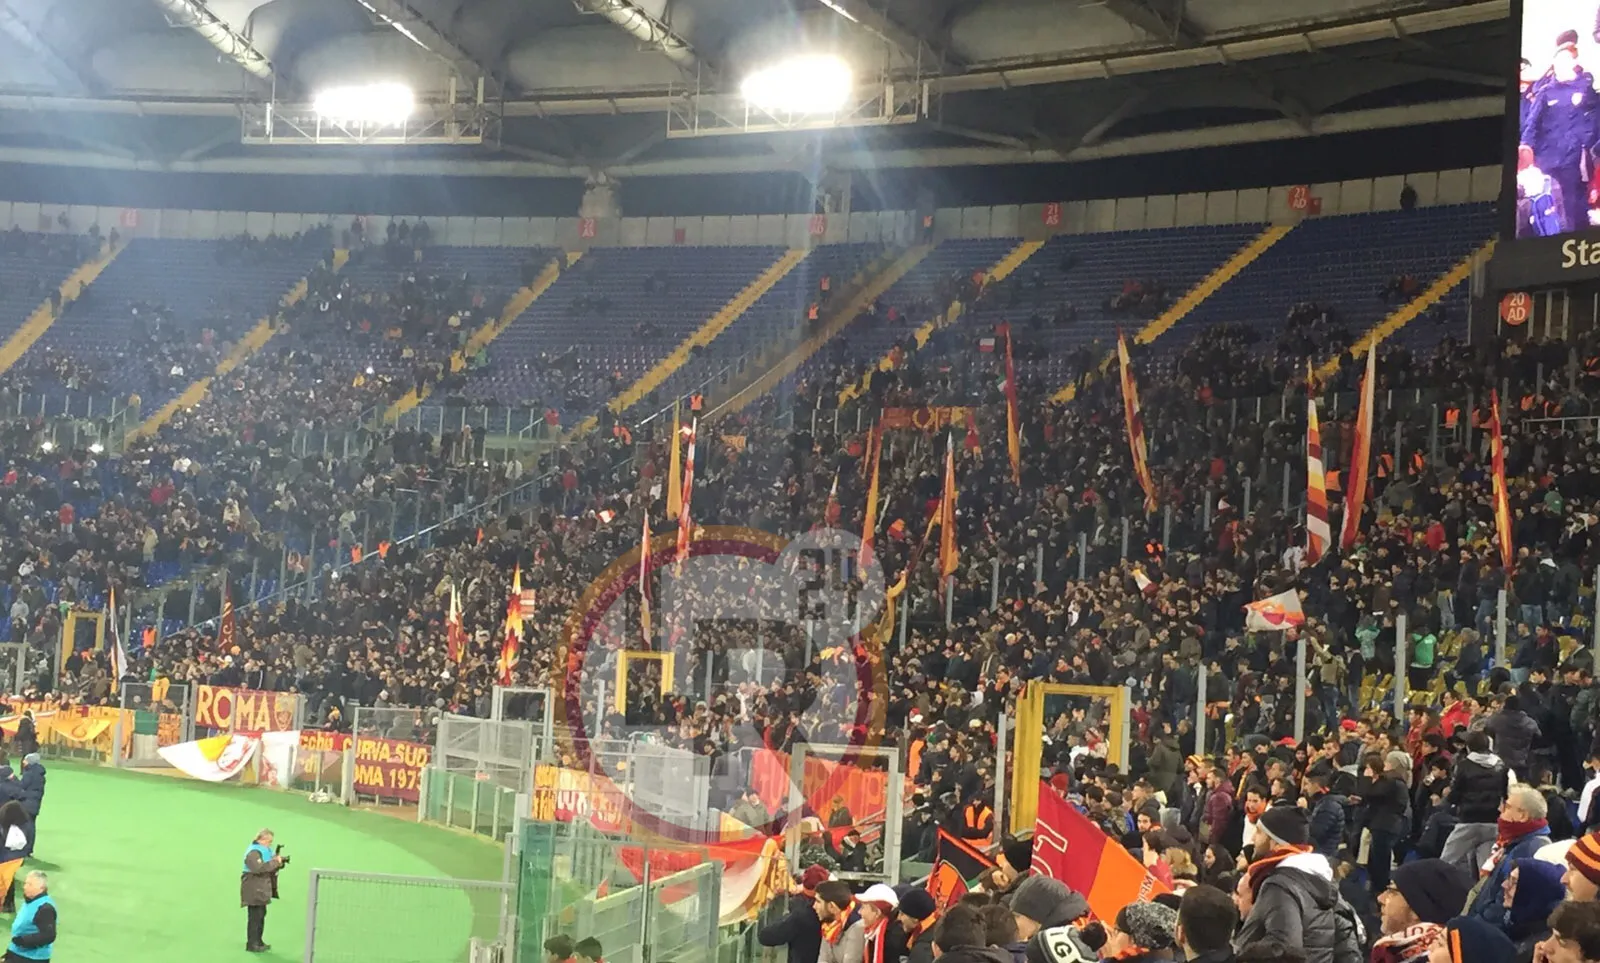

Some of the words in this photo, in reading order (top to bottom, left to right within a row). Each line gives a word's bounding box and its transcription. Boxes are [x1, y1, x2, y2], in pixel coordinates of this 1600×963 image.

[1294, 187, 1306, 198] 21
[1047, 203, 1058, 215] 21
[1509, 291, 1525, 306] 20
[1507, 307, 1526, 322] AD
[195, 684, 271, 731] ROMA
[395, 743, 428, 767] SUD
[353, 763, 384, 787] MA
